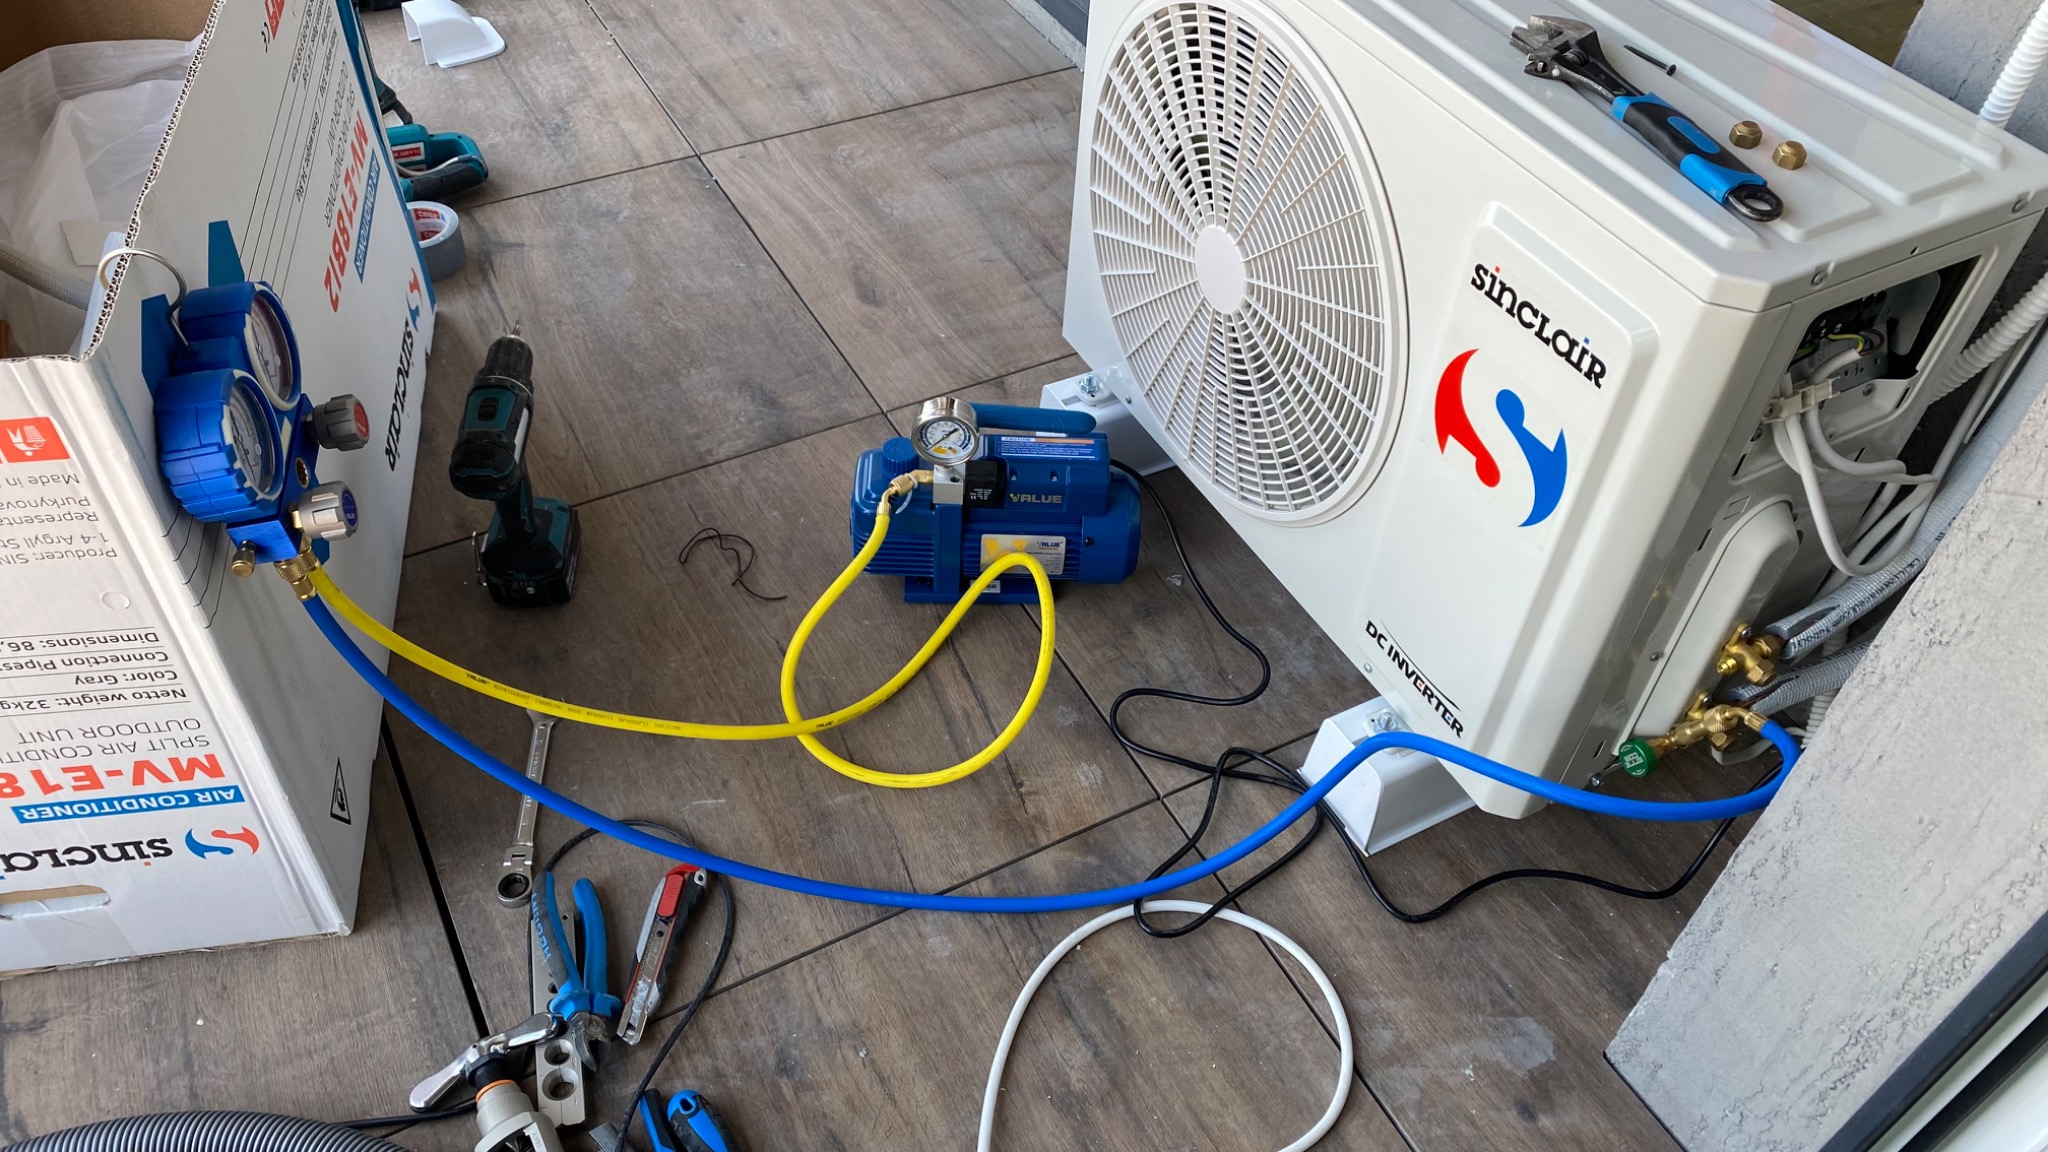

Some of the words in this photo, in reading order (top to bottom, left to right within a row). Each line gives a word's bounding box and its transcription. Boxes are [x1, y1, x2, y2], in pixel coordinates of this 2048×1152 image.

[333, 61, 348, 124] OUTDOOR
[345, 82, 356, 124] SPLIT
[327, 120, 338, 157] UNIT
[370, 162, 380, 181] AIR
[324, 140, 346, 228] CONDITIONER
[355, 181, 375, 274] CONDITIONER
[5, 477, 24, 488] in
[28, 473, 80, 487] Made
[1010, 493, 1062, 503] VALUE
[23, 534, 73, 548] Argyll
[80, 532, 109, 544] 1-4
[33, 548, 117, 564] Producer:
[0, 640, 35, 653] 86,
[40, 632, 160, 648] Dimensions:
[61, 651, 169, 667] Connection
[75, 674, 118, 685] Gray
[124, 669, 178, 682] Color:
[1365, 620, 1387, 650] DC
[1387, 645, 1464, 739] INVERTER
[57, 693, 127, 707] weight:
[132, 688, 187, 700] Netto
[0, 699, 51, 711] 32kg
[567, 706, 582, 715] HOSE
[78, 718, 201, 738] OUTDOOR
[17, 728, 74, 745] UNIT
[147, 735, 210, 751] SPLIT
[97, 741, 137, 755] AIR
[0, 753, 226, 798] MV-E18
[194, 788, 236, 803] AIR
[19, 793, 191, 820] CONDITIONER
